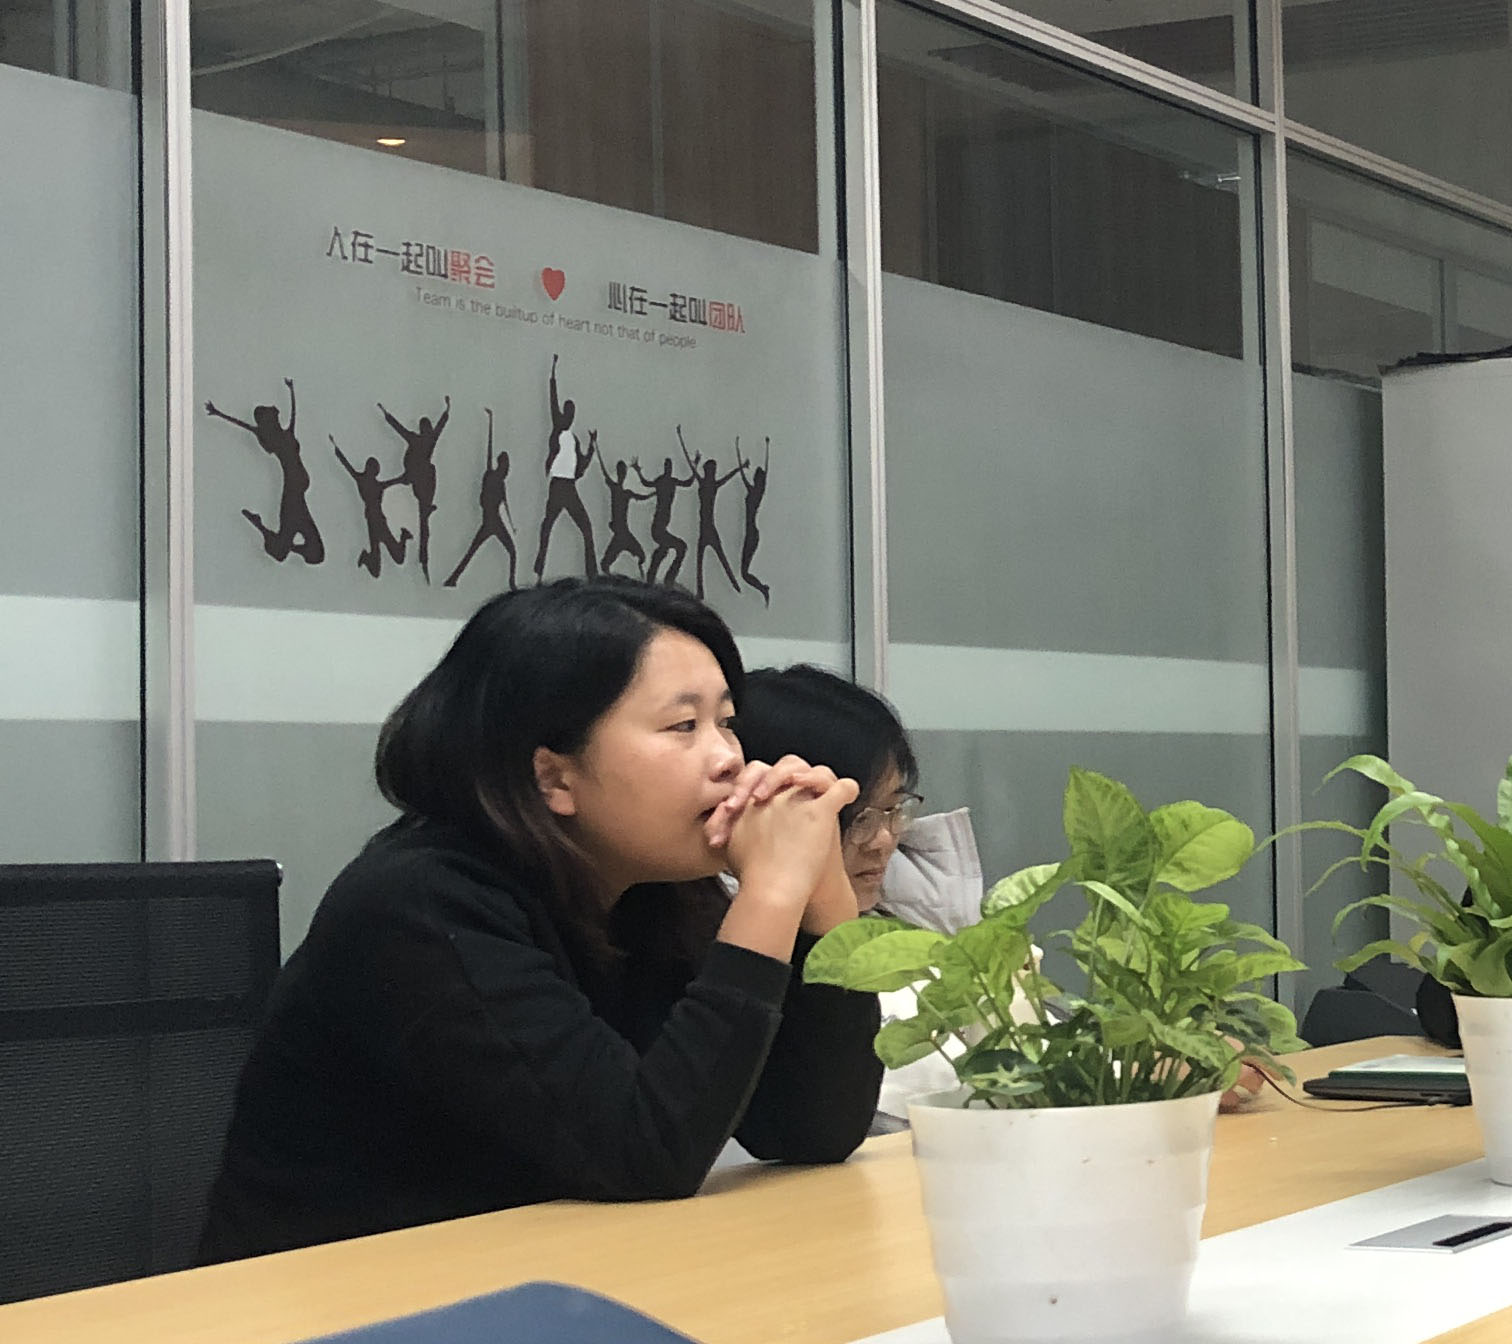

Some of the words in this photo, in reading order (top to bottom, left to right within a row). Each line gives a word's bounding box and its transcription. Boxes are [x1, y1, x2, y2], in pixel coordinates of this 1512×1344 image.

[326, 226, 496, 289] 人在一起叫聚会
[416, 286, 451, 308] Team
[455, 296, 466, 312] is
[470, 299, 491, 316] the
[542, 312, 555, 326] of
[559, 314, 591, 334] heart
[594, 322, 614, 333] not
[618, 325, 640, 342] that
[643, 328, 656, 344] of
[659, 332, 697, 349] people
[607, 281, 746, 334] 心在一起叫团队
